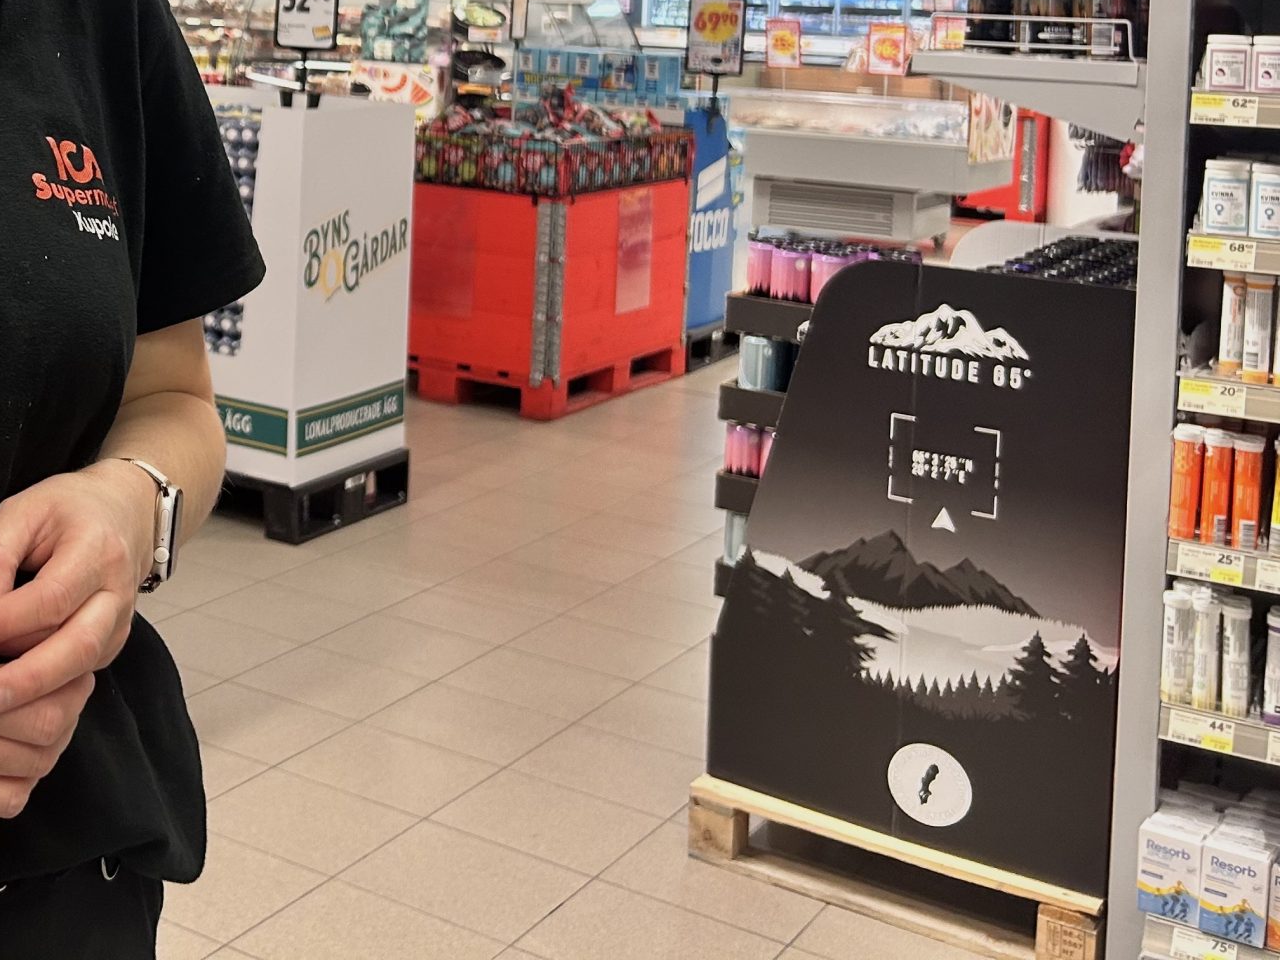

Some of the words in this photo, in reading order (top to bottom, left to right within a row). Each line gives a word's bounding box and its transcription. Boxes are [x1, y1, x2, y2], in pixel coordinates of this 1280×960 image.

[304, 209, 350, 289] BYNS
[343, 217, 408, 293] GÅRDAR
[868, 345, 980, 384] LATITUDE
[993, 364, 1032, 390] 65°
[224, 408, 253, 435] ÄGG
[304, 400, 382, 441] LOKALPRODUCERADE
[383, 394, 398, 417] ÄGG
[1146, 837, 1191, 861] Resorb
[1211, 855, 1257, 879] Resorb
